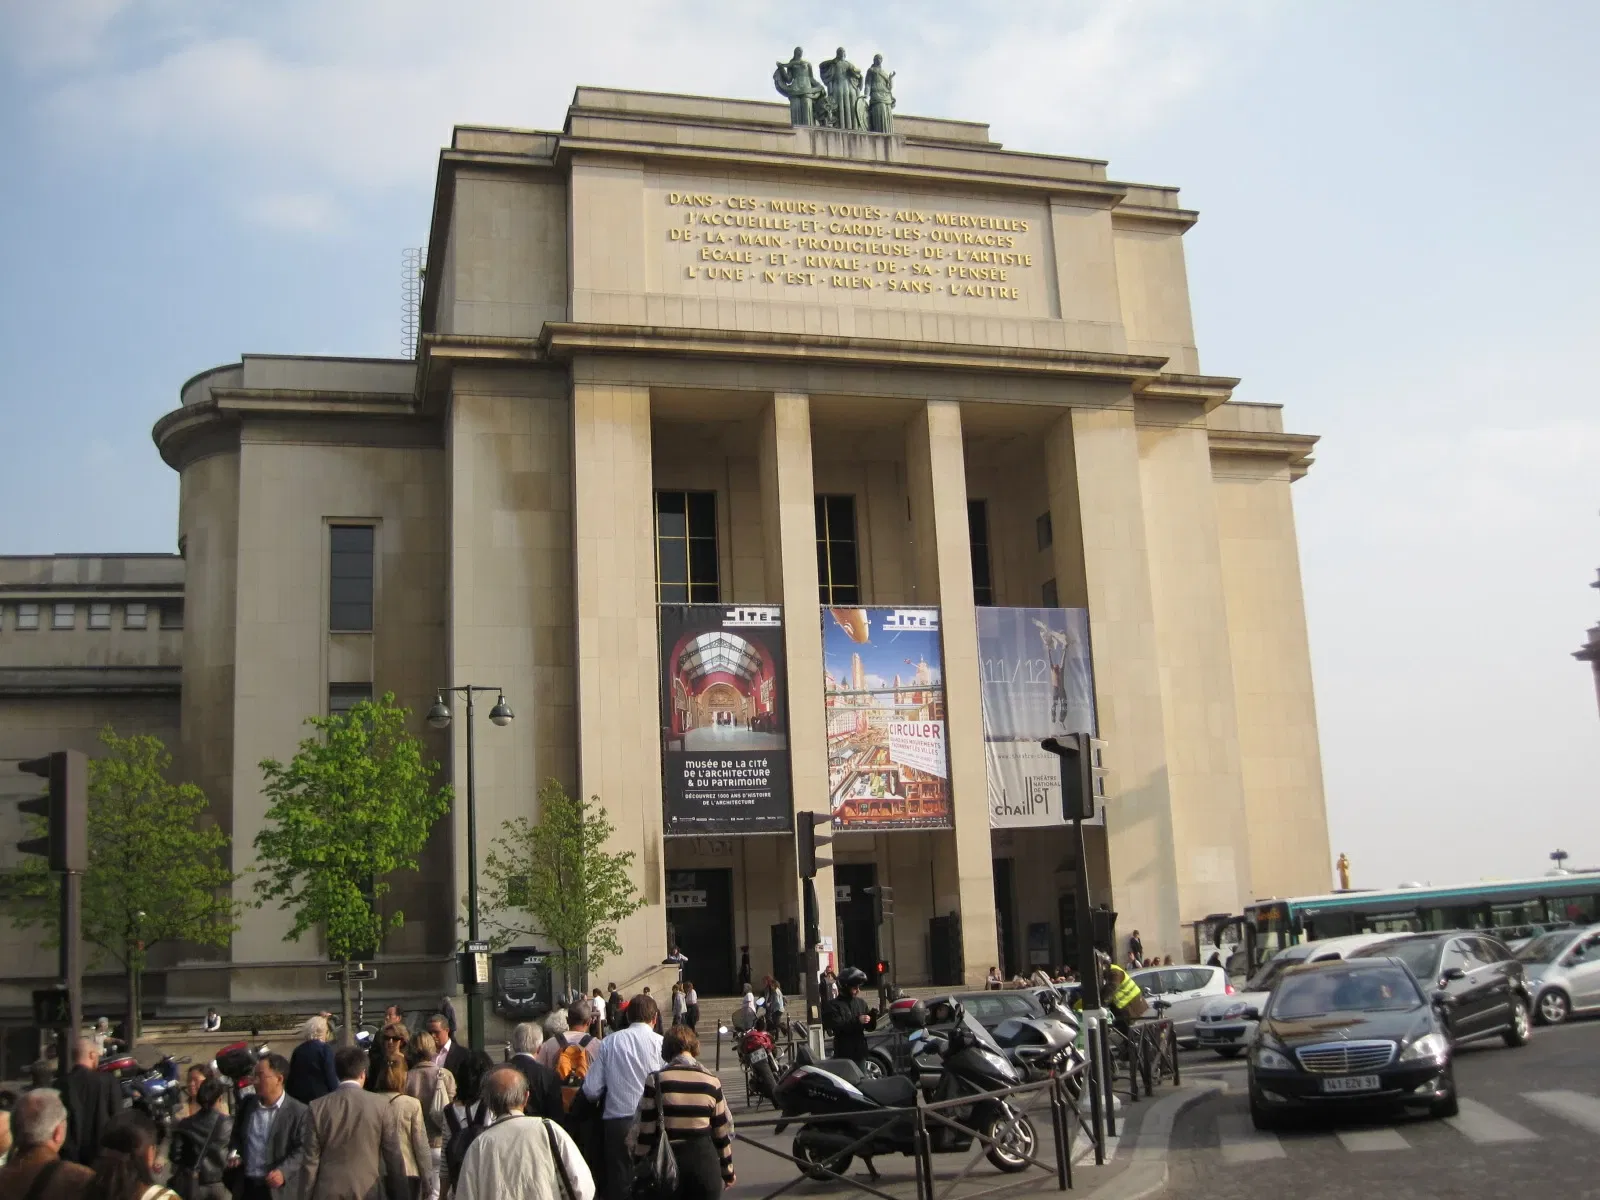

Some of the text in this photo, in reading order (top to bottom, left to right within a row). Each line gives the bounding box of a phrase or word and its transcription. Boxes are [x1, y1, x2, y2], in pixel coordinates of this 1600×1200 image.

[670, 193, 1029, 232] DANS CES MURS VOUÉS AUX MERVEILLES
[687, 211, 1014, 248] J'ACCUEILLE ET GARDE LES OUVRAGES
[670, 228, 1032, 267] DE LA MAIN PRODIGIEUSE DE L'ARTISTE
[701, 247, 1008, 282] ÉGALE ET RIVALE DE SA PENSÉE
[688, 265, 1020, 300] L'UNE N'EST RIEN SANS L'AUTRE
[985, 658, 1048, 684] 11/12
[921, 748, 939, 756] VILLES
[687, 779, 694, 787] &
